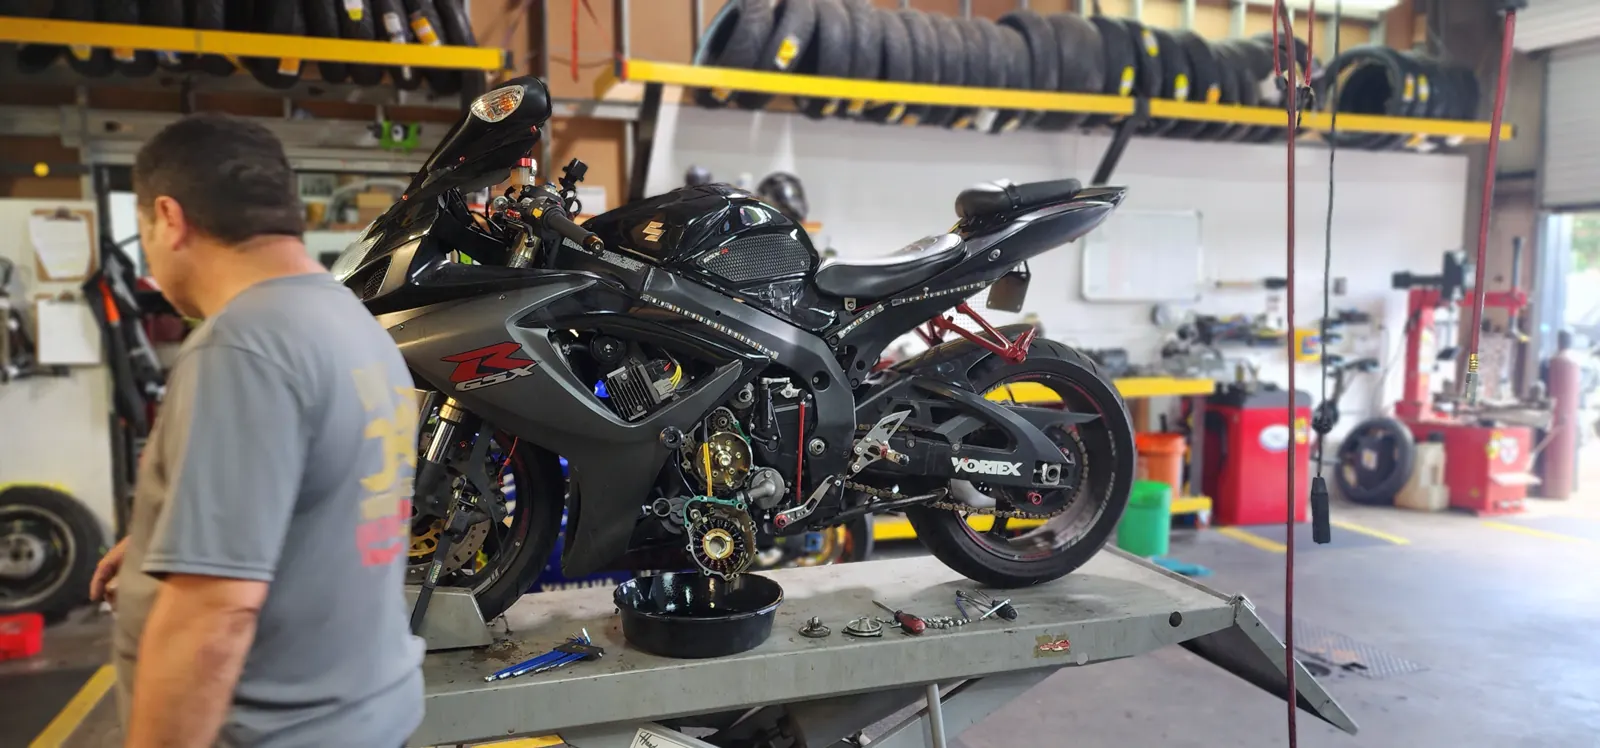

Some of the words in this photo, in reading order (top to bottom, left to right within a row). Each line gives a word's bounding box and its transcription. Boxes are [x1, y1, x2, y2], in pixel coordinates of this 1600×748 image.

[441, 341, 535, 382] R
[455, 362, 538, 391] GSX
[951, 457, 1023, 476] VORTEX
